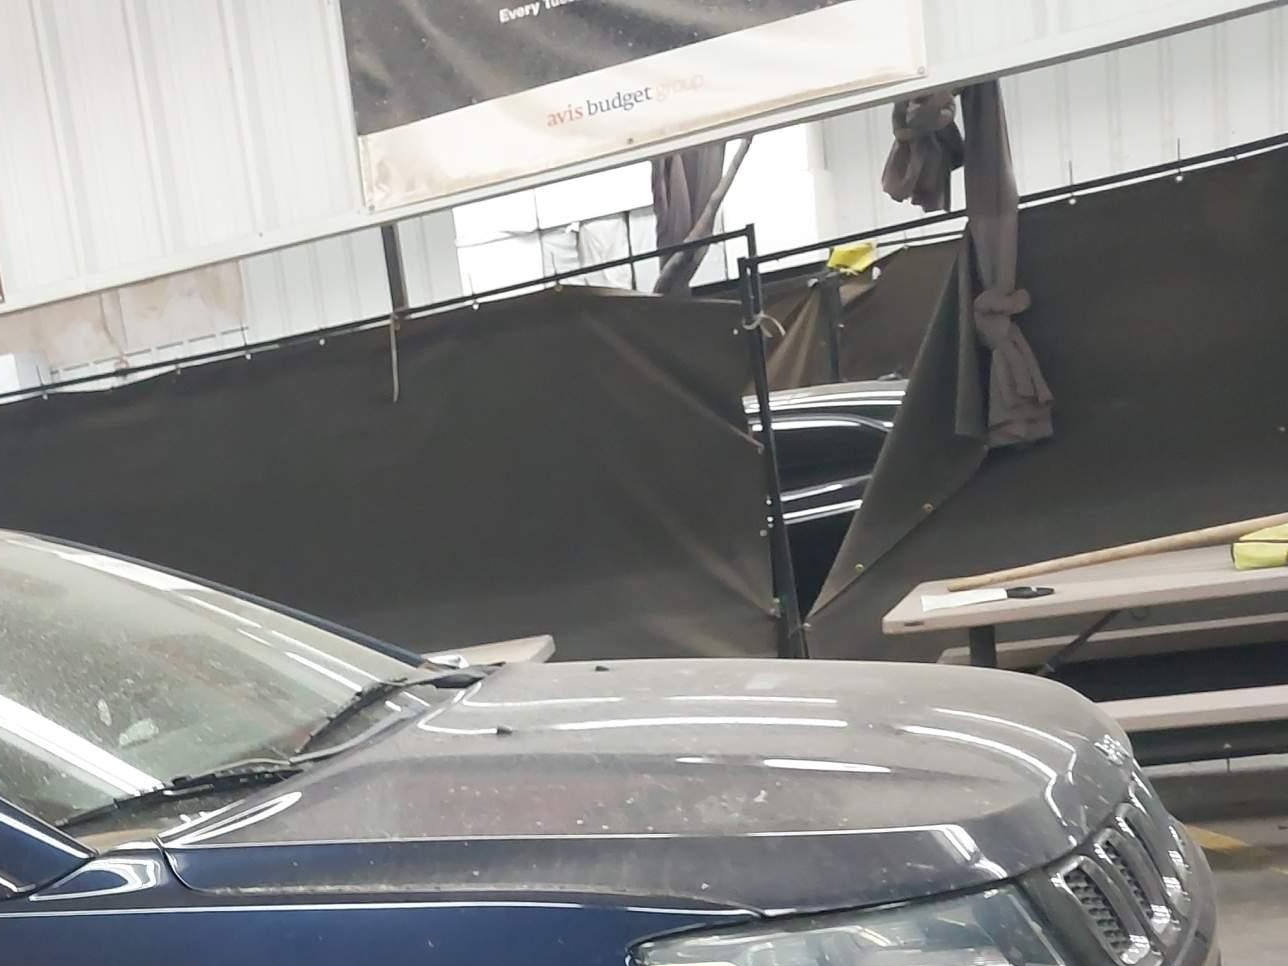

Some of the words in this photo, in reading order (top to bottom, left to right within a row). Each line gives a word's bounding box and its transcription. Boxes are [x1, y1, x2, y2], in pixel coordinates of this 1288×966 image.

[498, 2, 541, 23] Every
[546, 104, 584, 127] avis
[586, 86, 653, 117] budget
